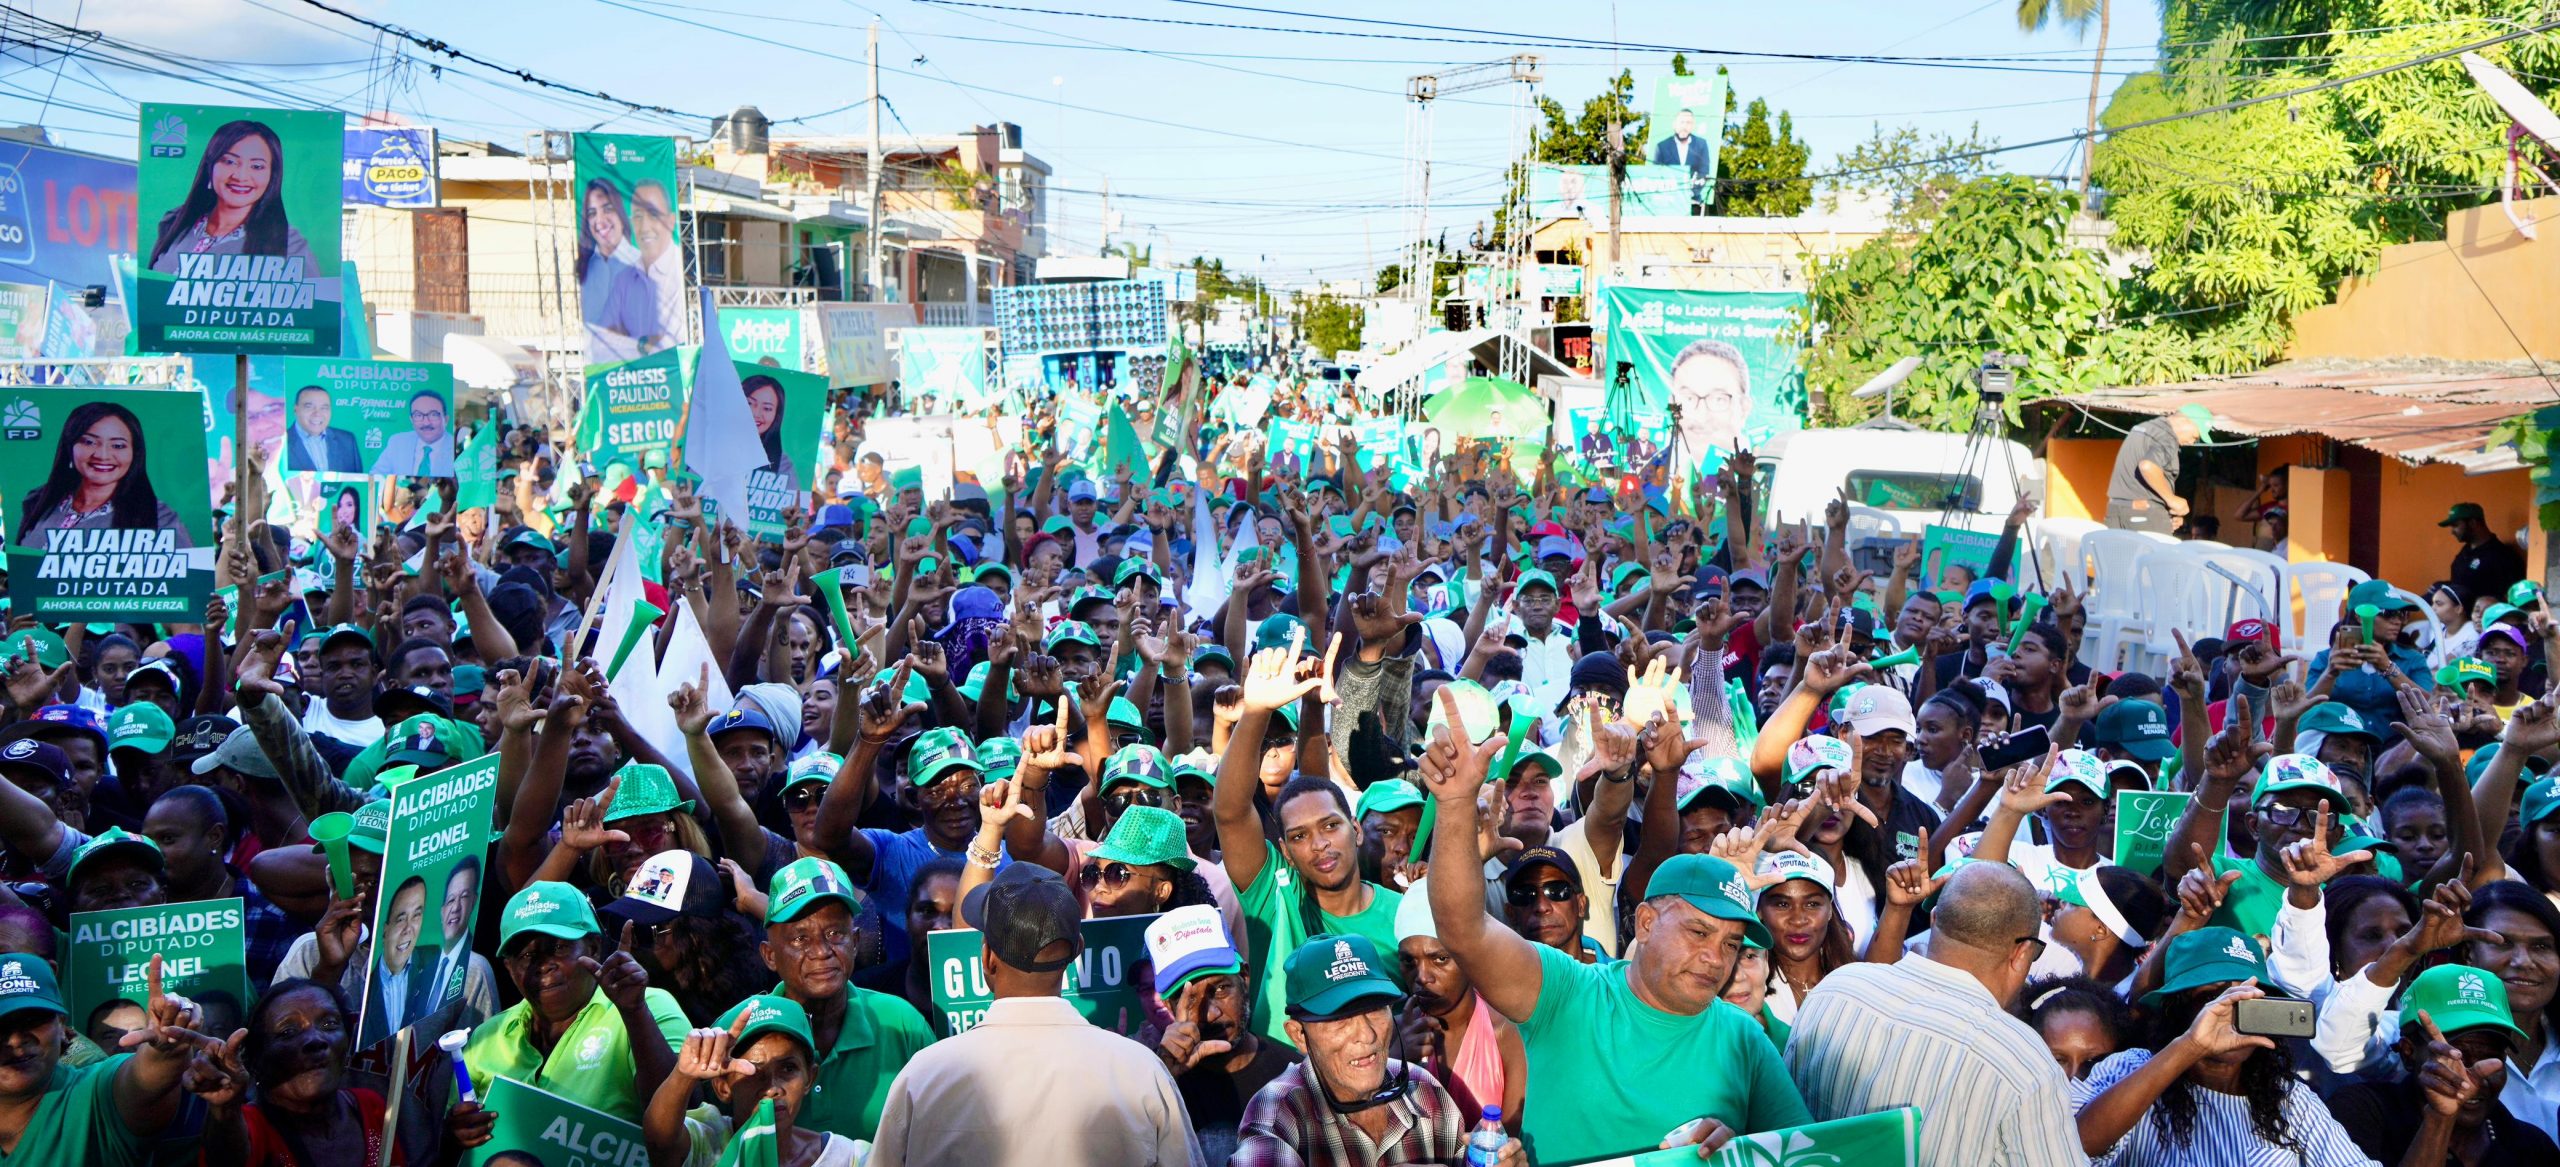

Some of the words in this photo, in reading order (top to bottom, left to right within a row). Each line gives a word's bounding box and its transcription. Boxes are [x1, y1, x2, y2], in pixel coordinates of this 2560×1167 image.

[153, 147, 184, 156] FP
[376, 168, 418, 179] PAGO
[178, 253, 305, 281] YAJAIRA
[166, 281, 315, 309] ANGLADA
[184, 310, 295, 327] DIPUTADA
[1665, 304, 1682, 317] de
[1686, 305, 1722, 317] Labor
[169, 330, 210, 341] AHORA
[210, 331, 236, 341] CON
[239, 330, 265, 341] MÁS
[267, 332, 310, 342] FUERZA
[734, 318, 790, 338] Mabel
[1665, 322, 1708, 335] Social
[1711, 325, 1718, 338] y
[1722, 324, 1741, 336] de
[731, 330, 787, 353] Ortiz
[316, 363, 430, 382] ALCIBÍADES
[606, 367, 668, 388] GÉNESIS
[334, 380, 412, 392] DIPUTADO
[609, 385, 671, 404] PAULINO
[609, 402, 671, 414] VICEALCALDESA
[7, 430, 39, 439] FP
[608, 419, 675, 446] SERGIO
[46, 529, 176, 554] YAJAIRA
[37, 553, 188, 579] ANGLADA
[57, 581, 169, 595] DIPUTADA
[42, 601, 83, 610] AHORA
[86, 601, 111, 610] CON
[113, 599, 139, 610] MÁS
[141, 601, 184, 610] FUERZA
[2459, 660, 2492, 675] Leonel
[394, 766, 496, 819] ALCIBÍADES
[408, 794, 478, 832] DIPUTADO
[408, 821, 470, 861] LEONEL
[411, 844, 464, 871] PRESIDENTE
[1780, 859, 1810, 869] DIPUTADA
[782, 886, 806, 904] DIPUTADO
[514, 901, 561, 919] Alcibíades
[75, 909, 240, 944] ALCIBÍADES
[1174, 926, 1213, 941] Diputado
[101, 933, 215, 957] DIPUTADO
[1324, 962, 1370, 979] LEONEL
[1332, 970, 1367, 982] PRESIDENTE
[118, 977, 201, 994] PRESDENTE
